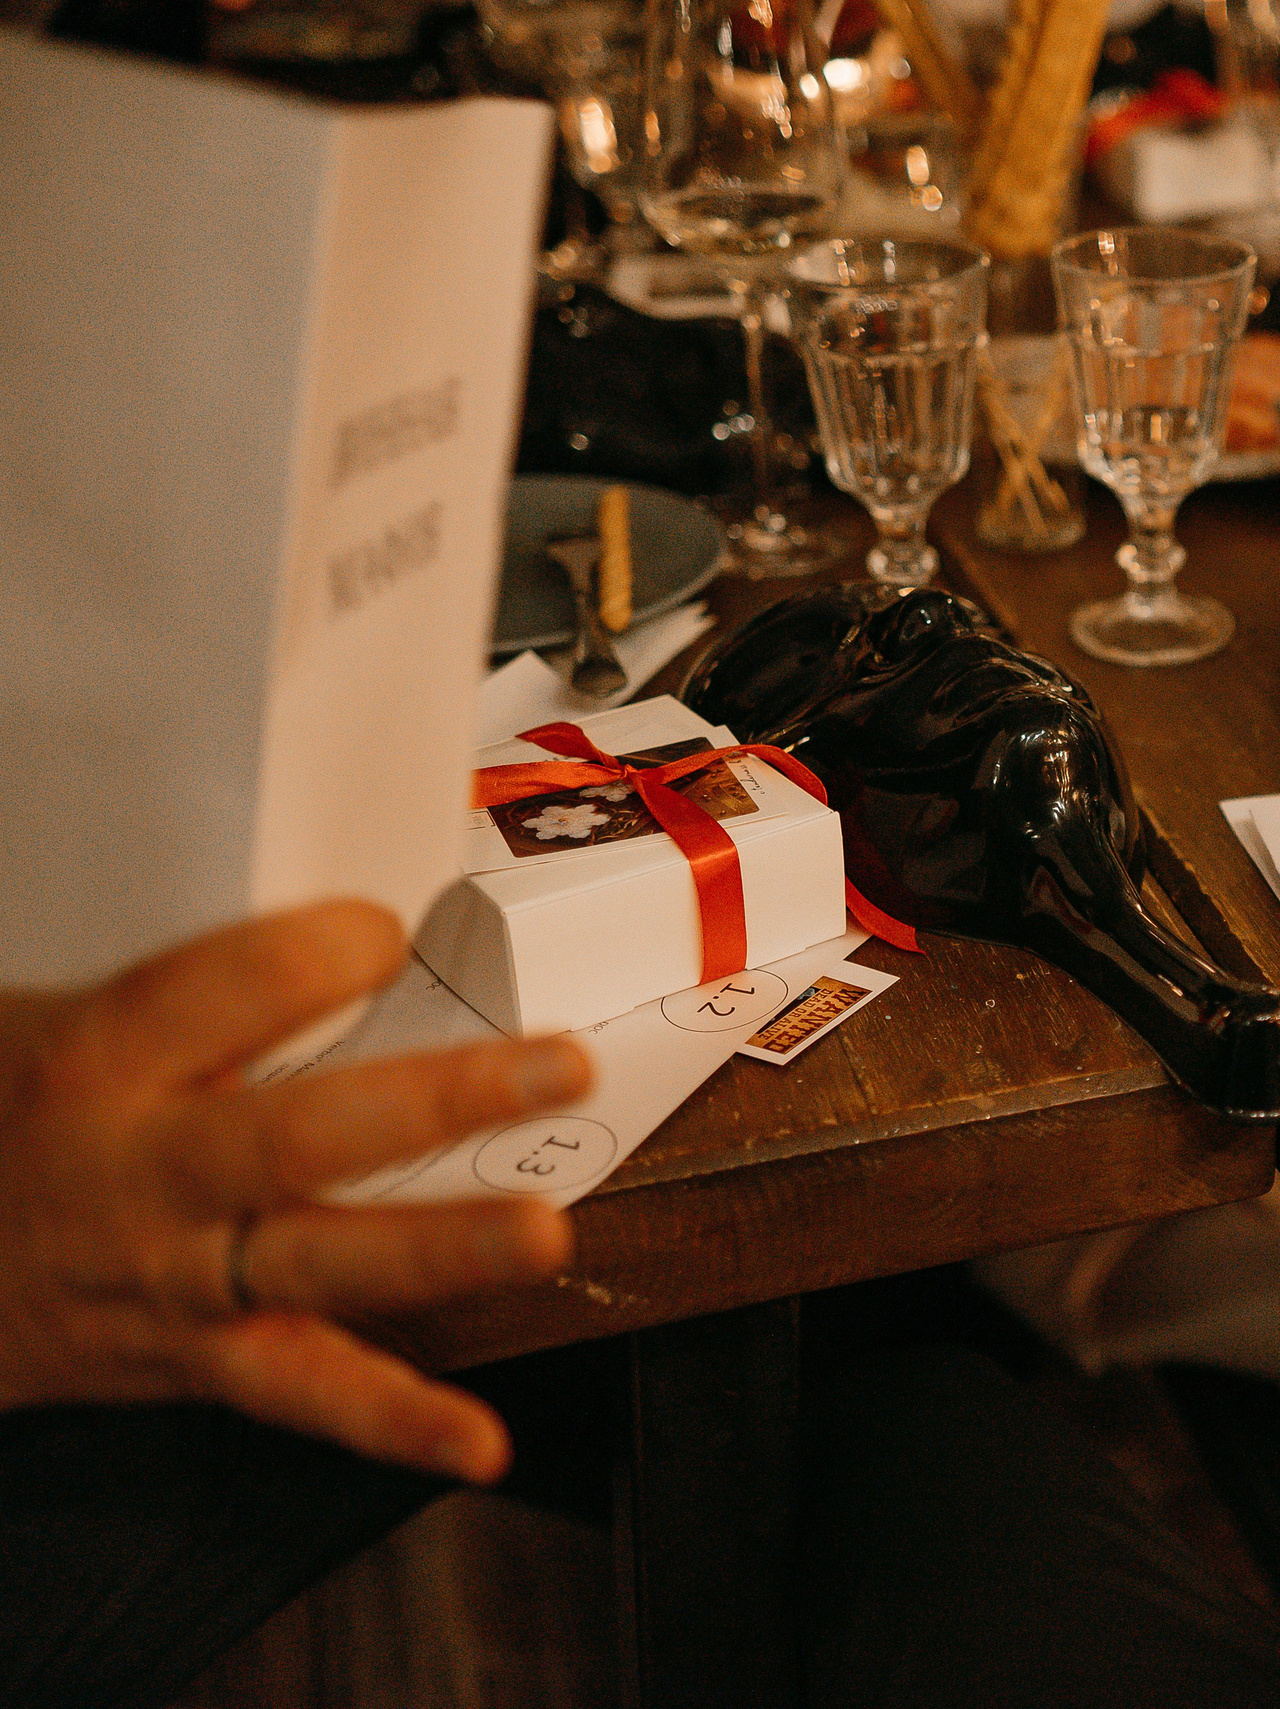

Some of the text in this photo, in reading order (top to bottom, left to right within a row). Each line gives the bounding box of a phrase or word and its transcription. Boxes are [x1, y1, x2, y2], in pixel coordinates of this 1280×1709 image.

[696, 981, 756, 1017] 1.2
[758, 988, 833, 1040] DEAD OR ALIVE
[763, 988, 867, 1051] WANTED
[516, 1136, 580, 1176] 1.3
